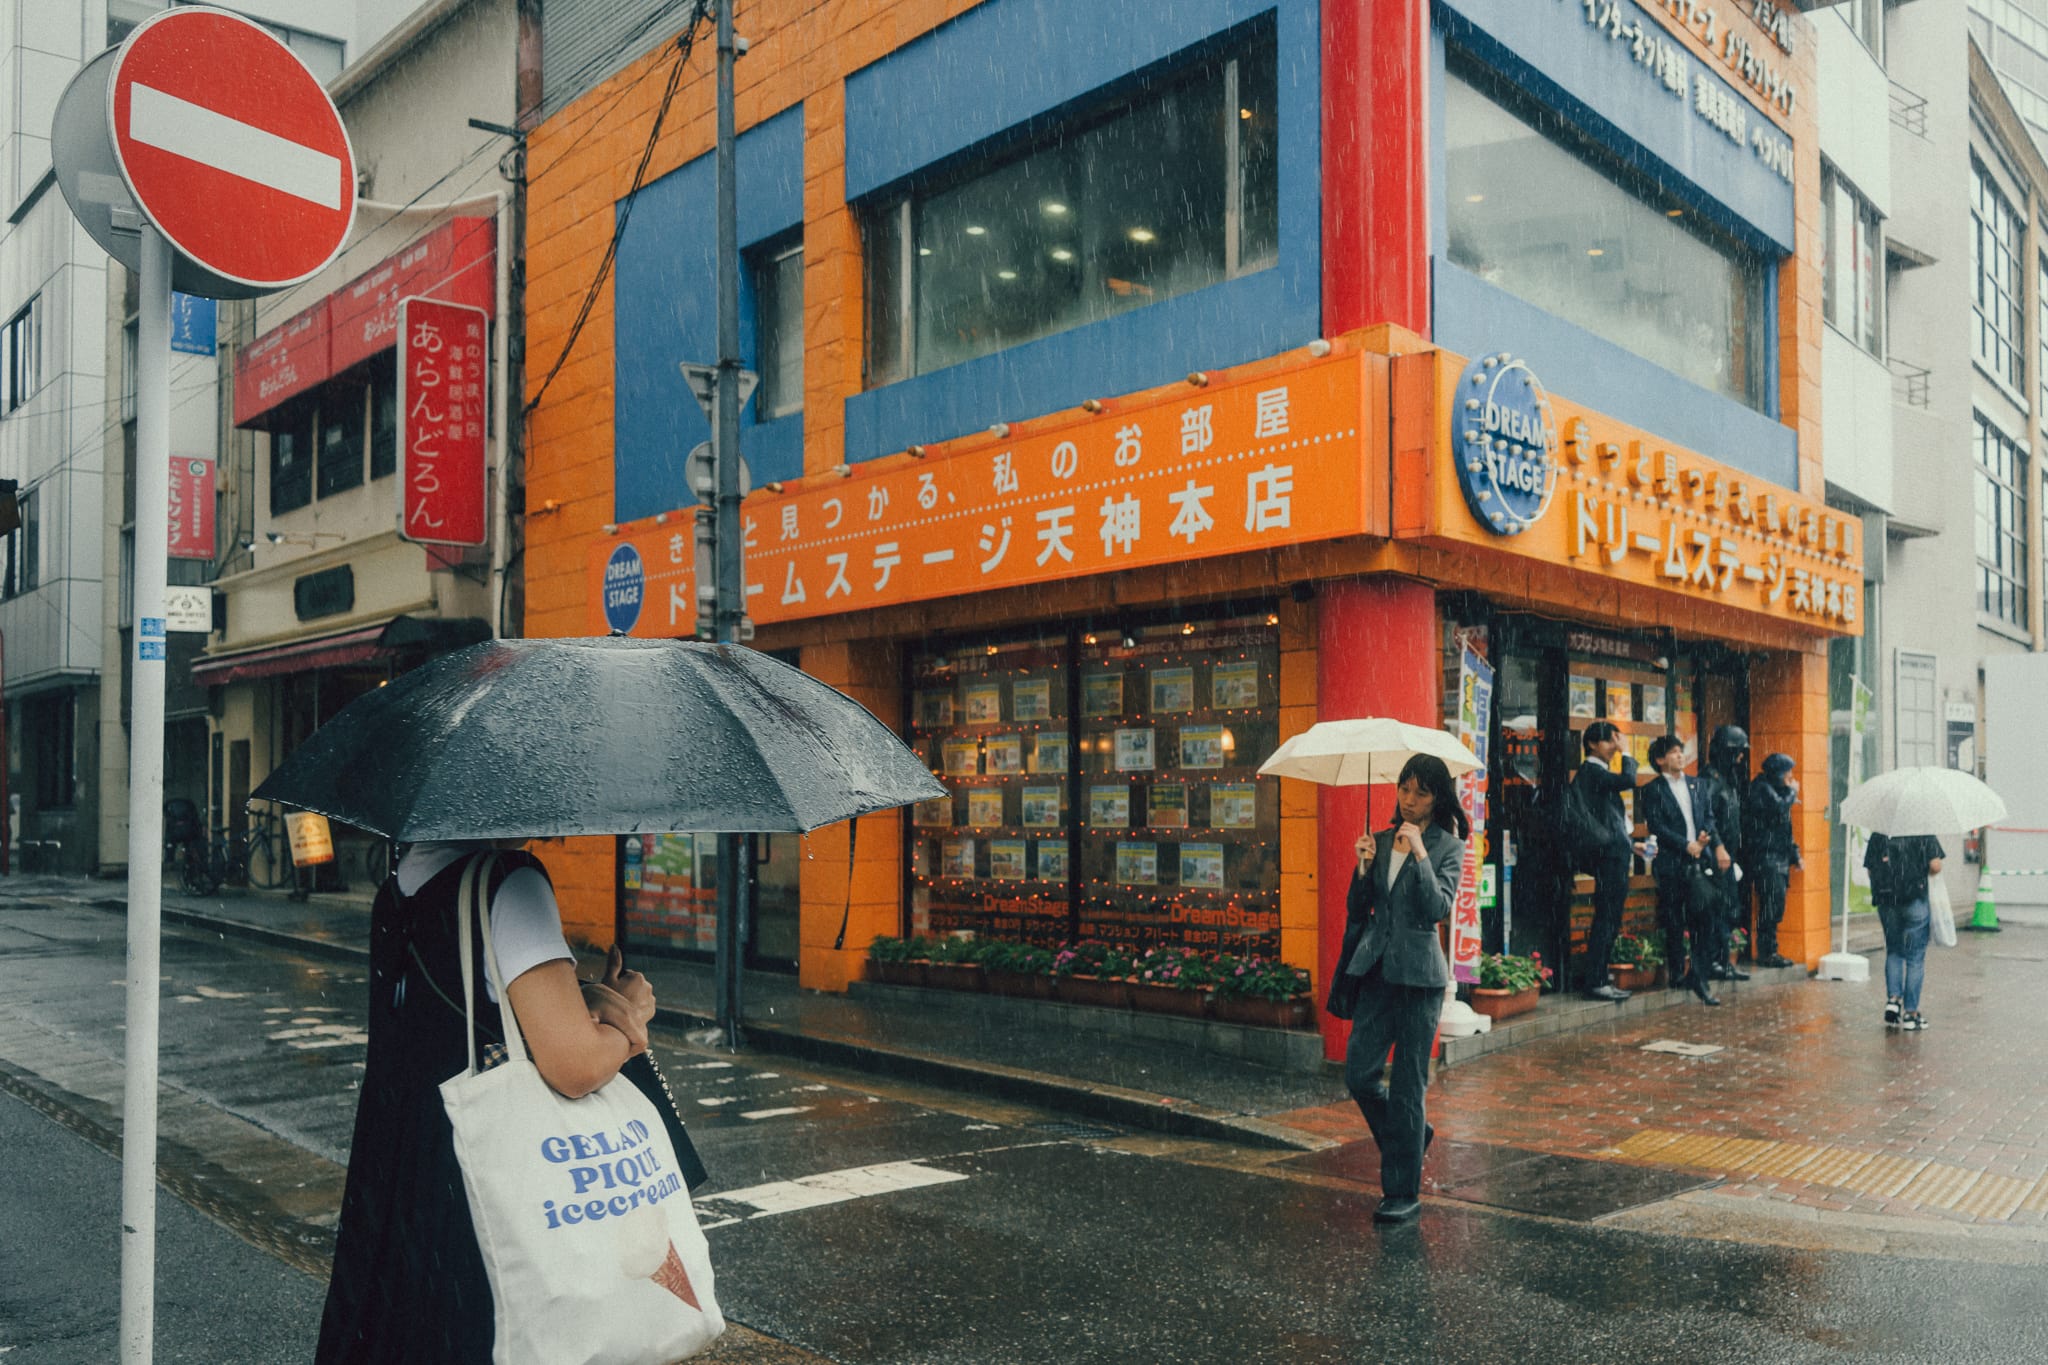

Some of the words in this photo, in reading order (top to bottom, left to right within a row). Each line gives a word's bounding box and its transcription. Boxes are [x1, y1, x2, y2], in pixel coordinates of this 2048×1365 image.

[411, 320, 444, 528] あらんどろん
[1484, 401, 1546, 448] DREAM
[669, 386, 1290, 564] きと見つかる、私のお部屋
[1486, 451, 1544, 496] STAGE
[670, 463, 1294, 625] ドームステージ天神本店
[607, 555, 641, 582] DREAM
[608, 586, 639, 608] STAGE
[983, 893, 1070, 918] DreamStage
[1170, 903, 1280, 932] DreamStage
[1098, 923, 1140, 938] マンション
[1144, 926, 1179, 940] アパート
[567, 1146, 662, 1194] PIQUE
[543, 1171, 681, 1230] icecream
